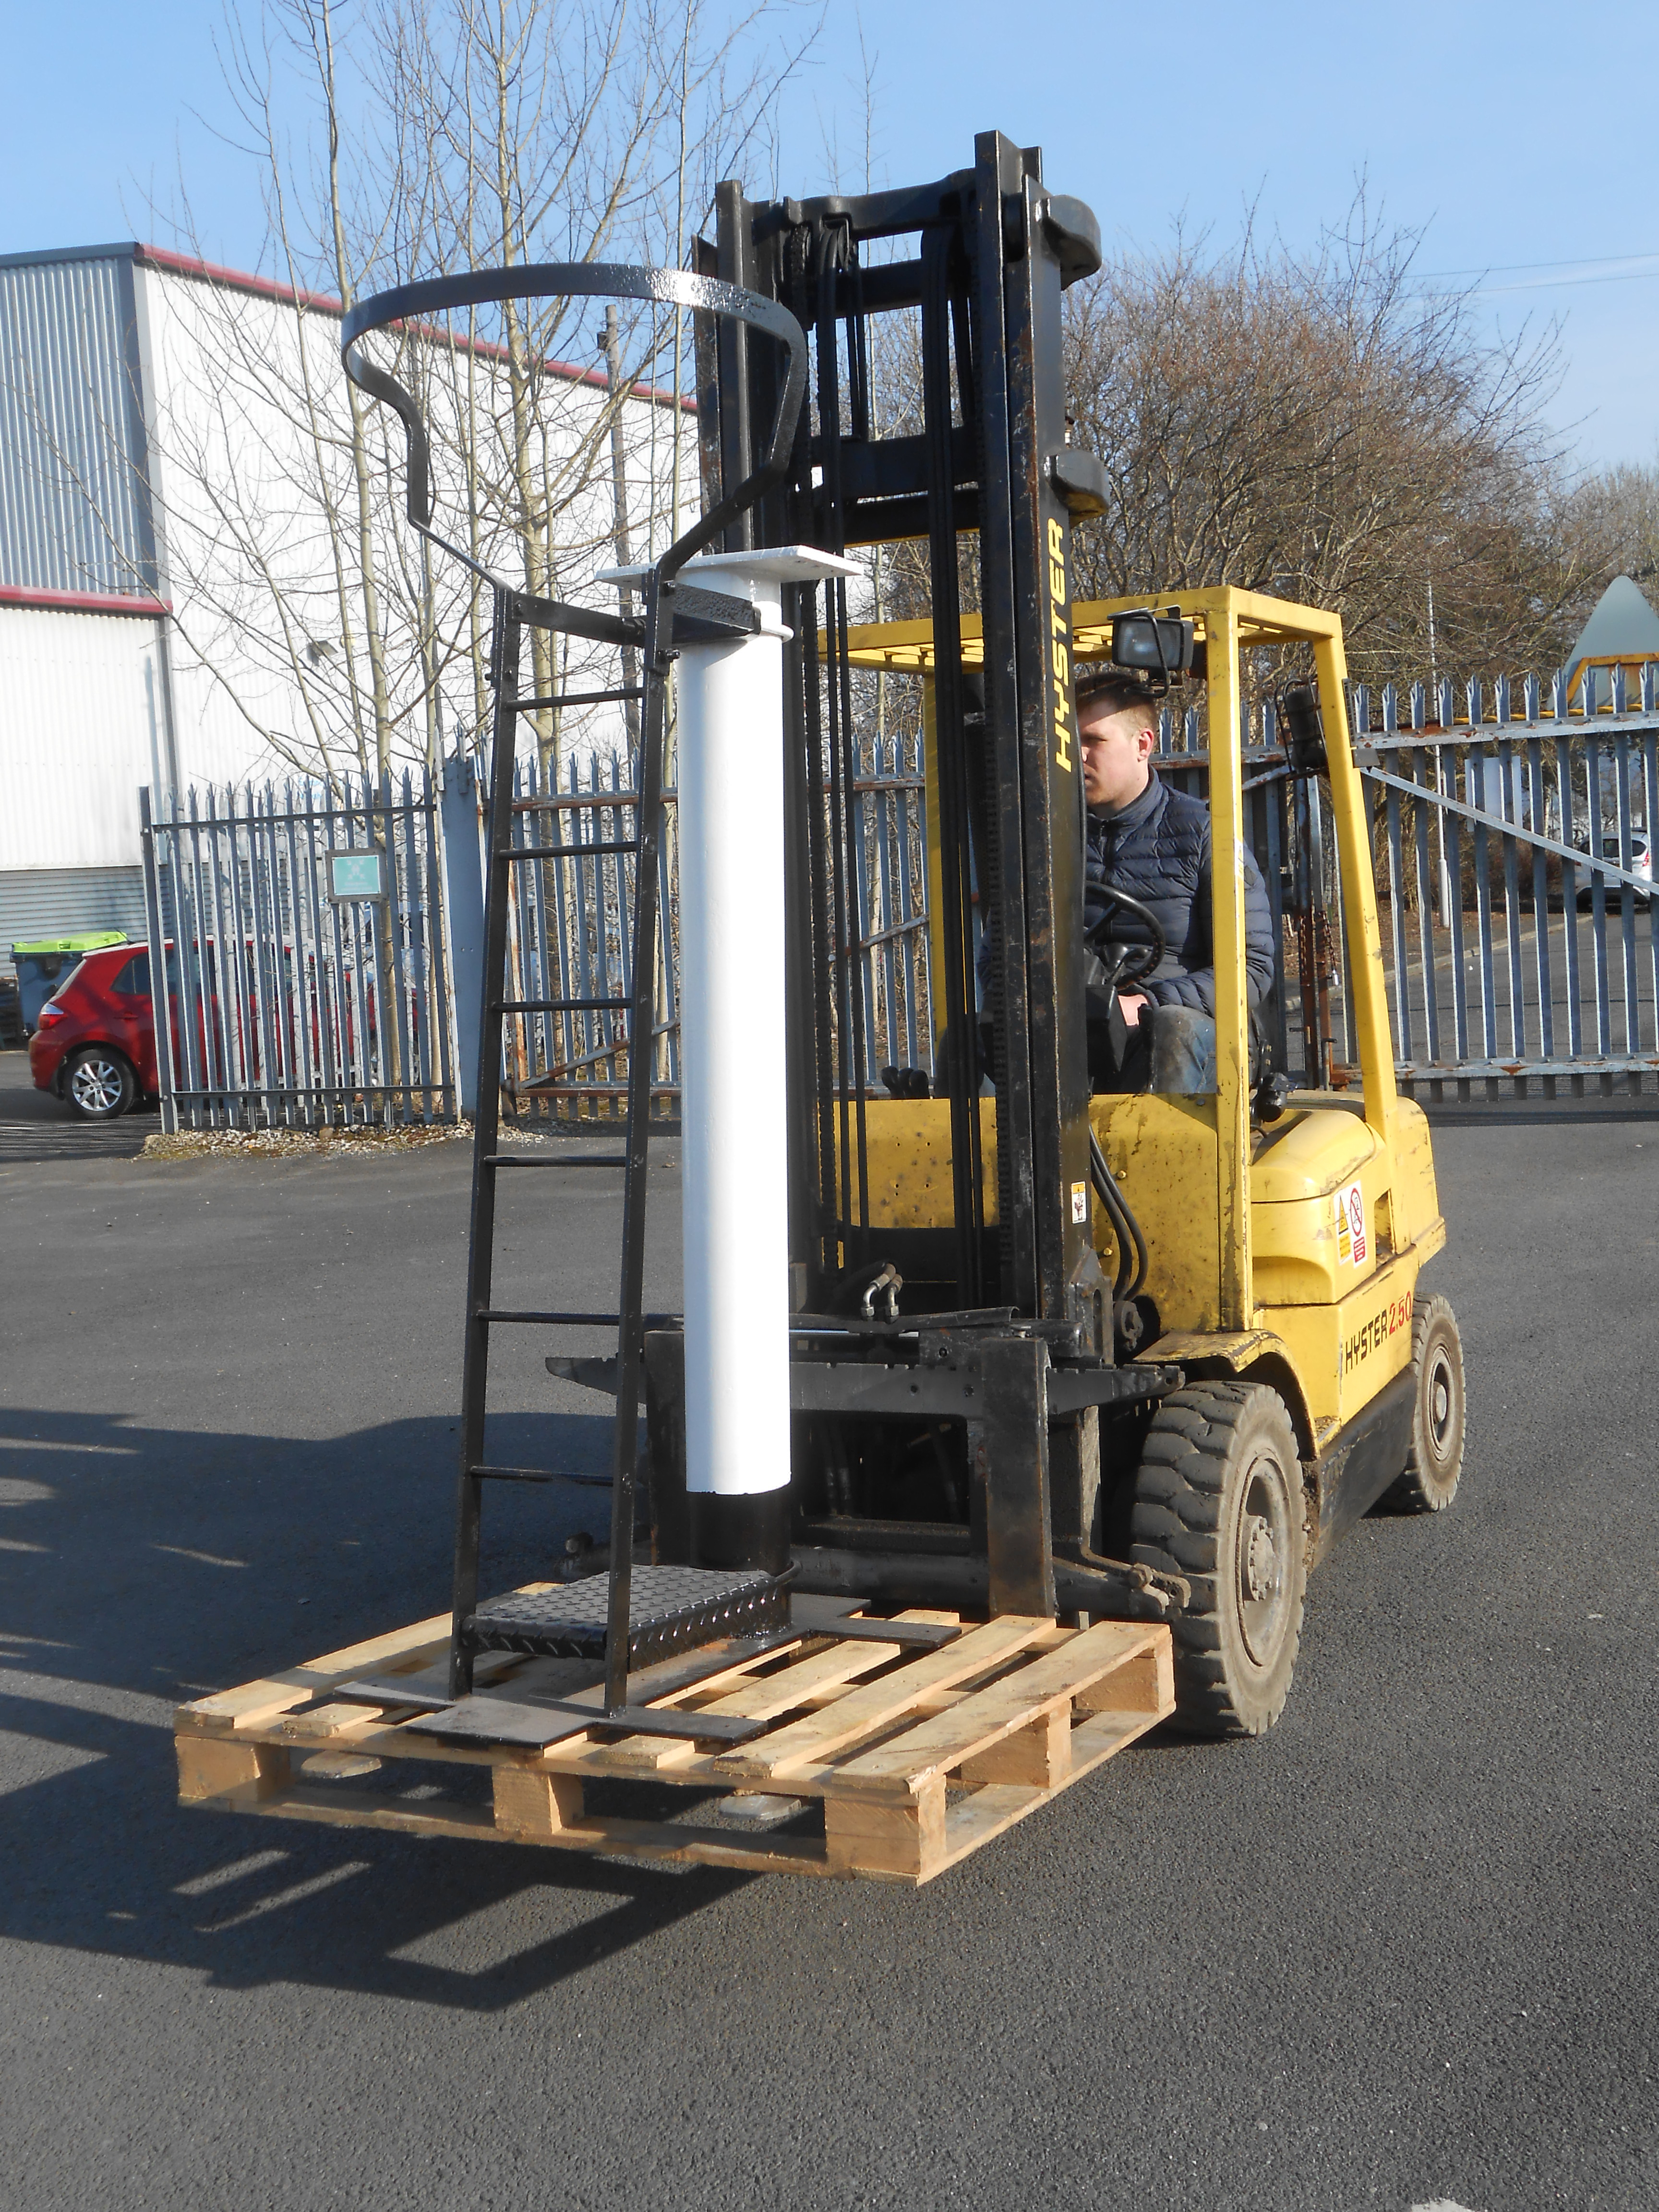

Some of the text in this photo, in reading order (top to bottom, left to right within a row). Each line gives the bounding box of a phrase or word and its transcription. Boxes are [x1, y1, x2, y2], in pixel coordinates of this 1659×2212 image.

[1048, 518, 1071, 772] HYSTER
[1345, 1290, 1412, 1374] HYSTER 2.50
